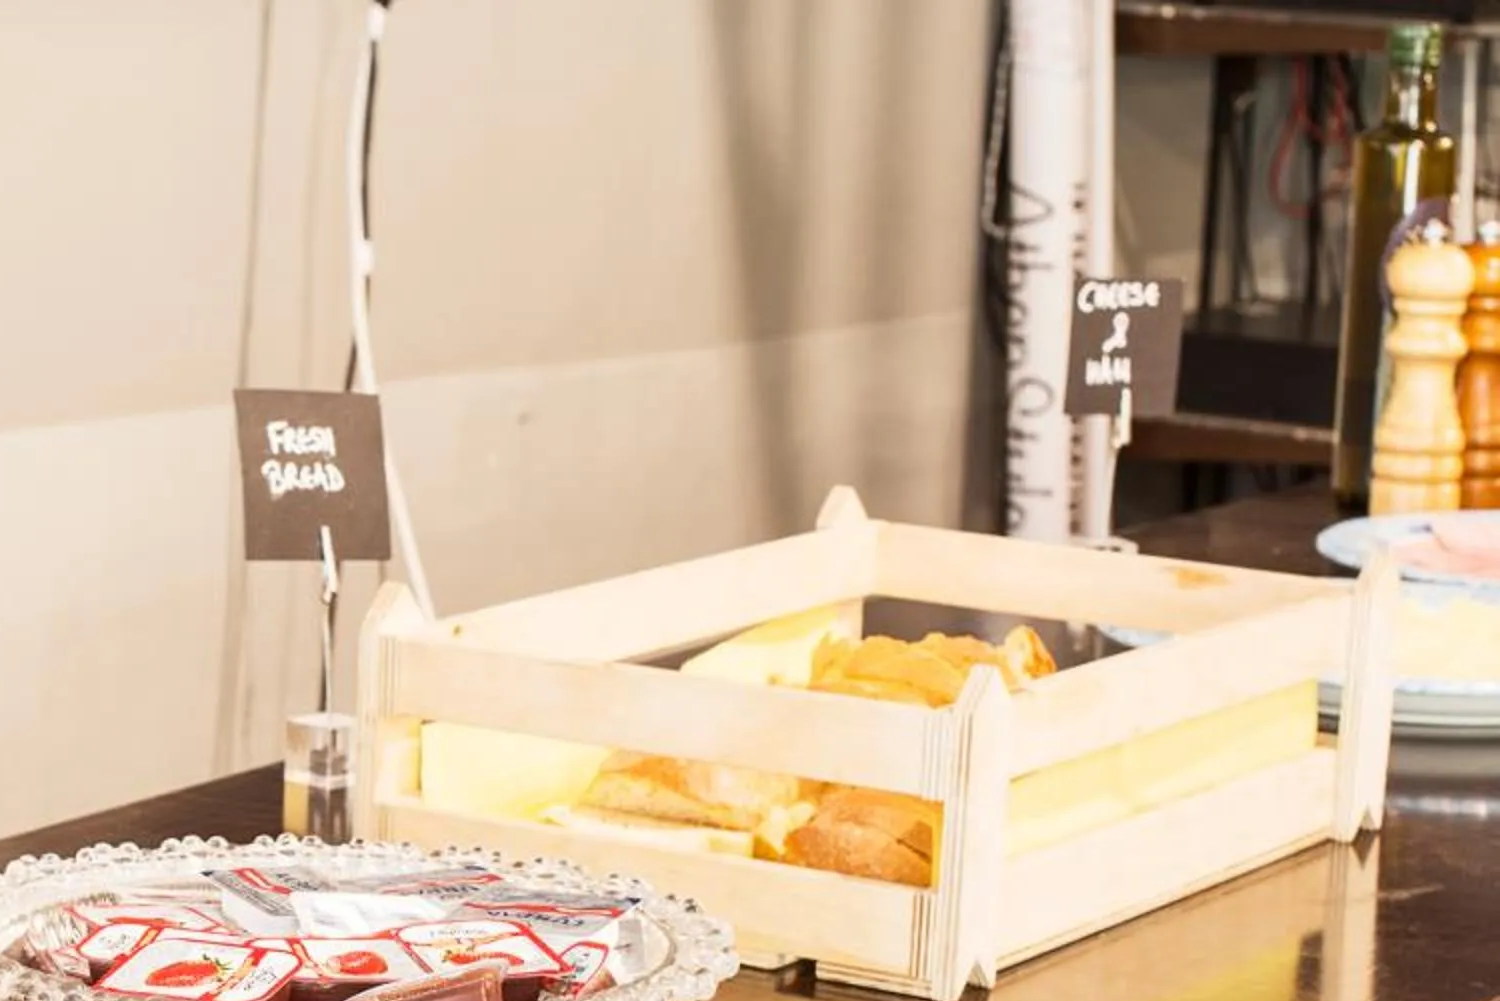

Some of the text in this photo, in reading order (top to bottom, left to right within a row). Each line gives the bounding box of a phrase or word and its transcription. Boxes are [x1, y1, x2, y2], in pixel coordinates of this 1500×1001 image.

[1077, 280, 1160, 313] CHEESE
[1085, 354, 1133, 386] HAM
[266, 420, 337, 457] FRESH
[260, 459, 346, 500] BREAD
